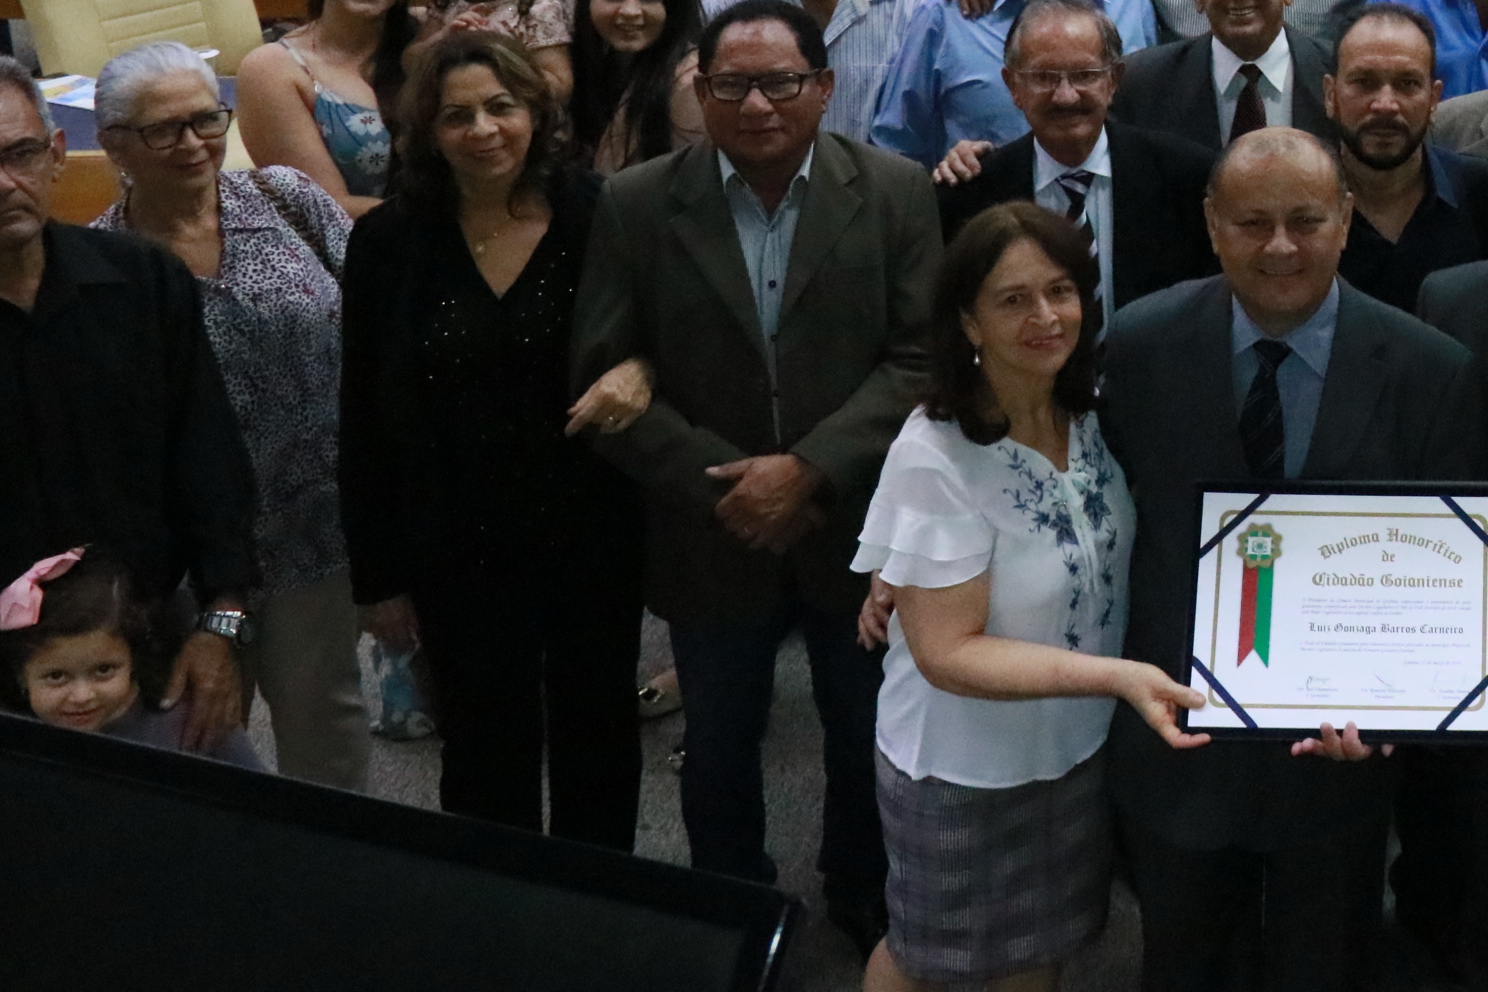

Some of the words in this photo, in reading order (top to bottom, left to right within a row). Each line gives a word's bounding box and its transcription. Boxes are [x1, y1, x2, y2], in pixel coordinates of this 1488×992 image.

[1317, 532, 1380, 560] Diploma
[1381, 550, 1396, 562] de
[1311, 572, 1375, 588] Cidadão
[1380, 574, 1463, 588] Goianiense
[1334, 623, 1377, 634] Gonzaga
[1380, 623, 1416, 634] Barros
[1419, 624, 1464, 634] Carneiro
